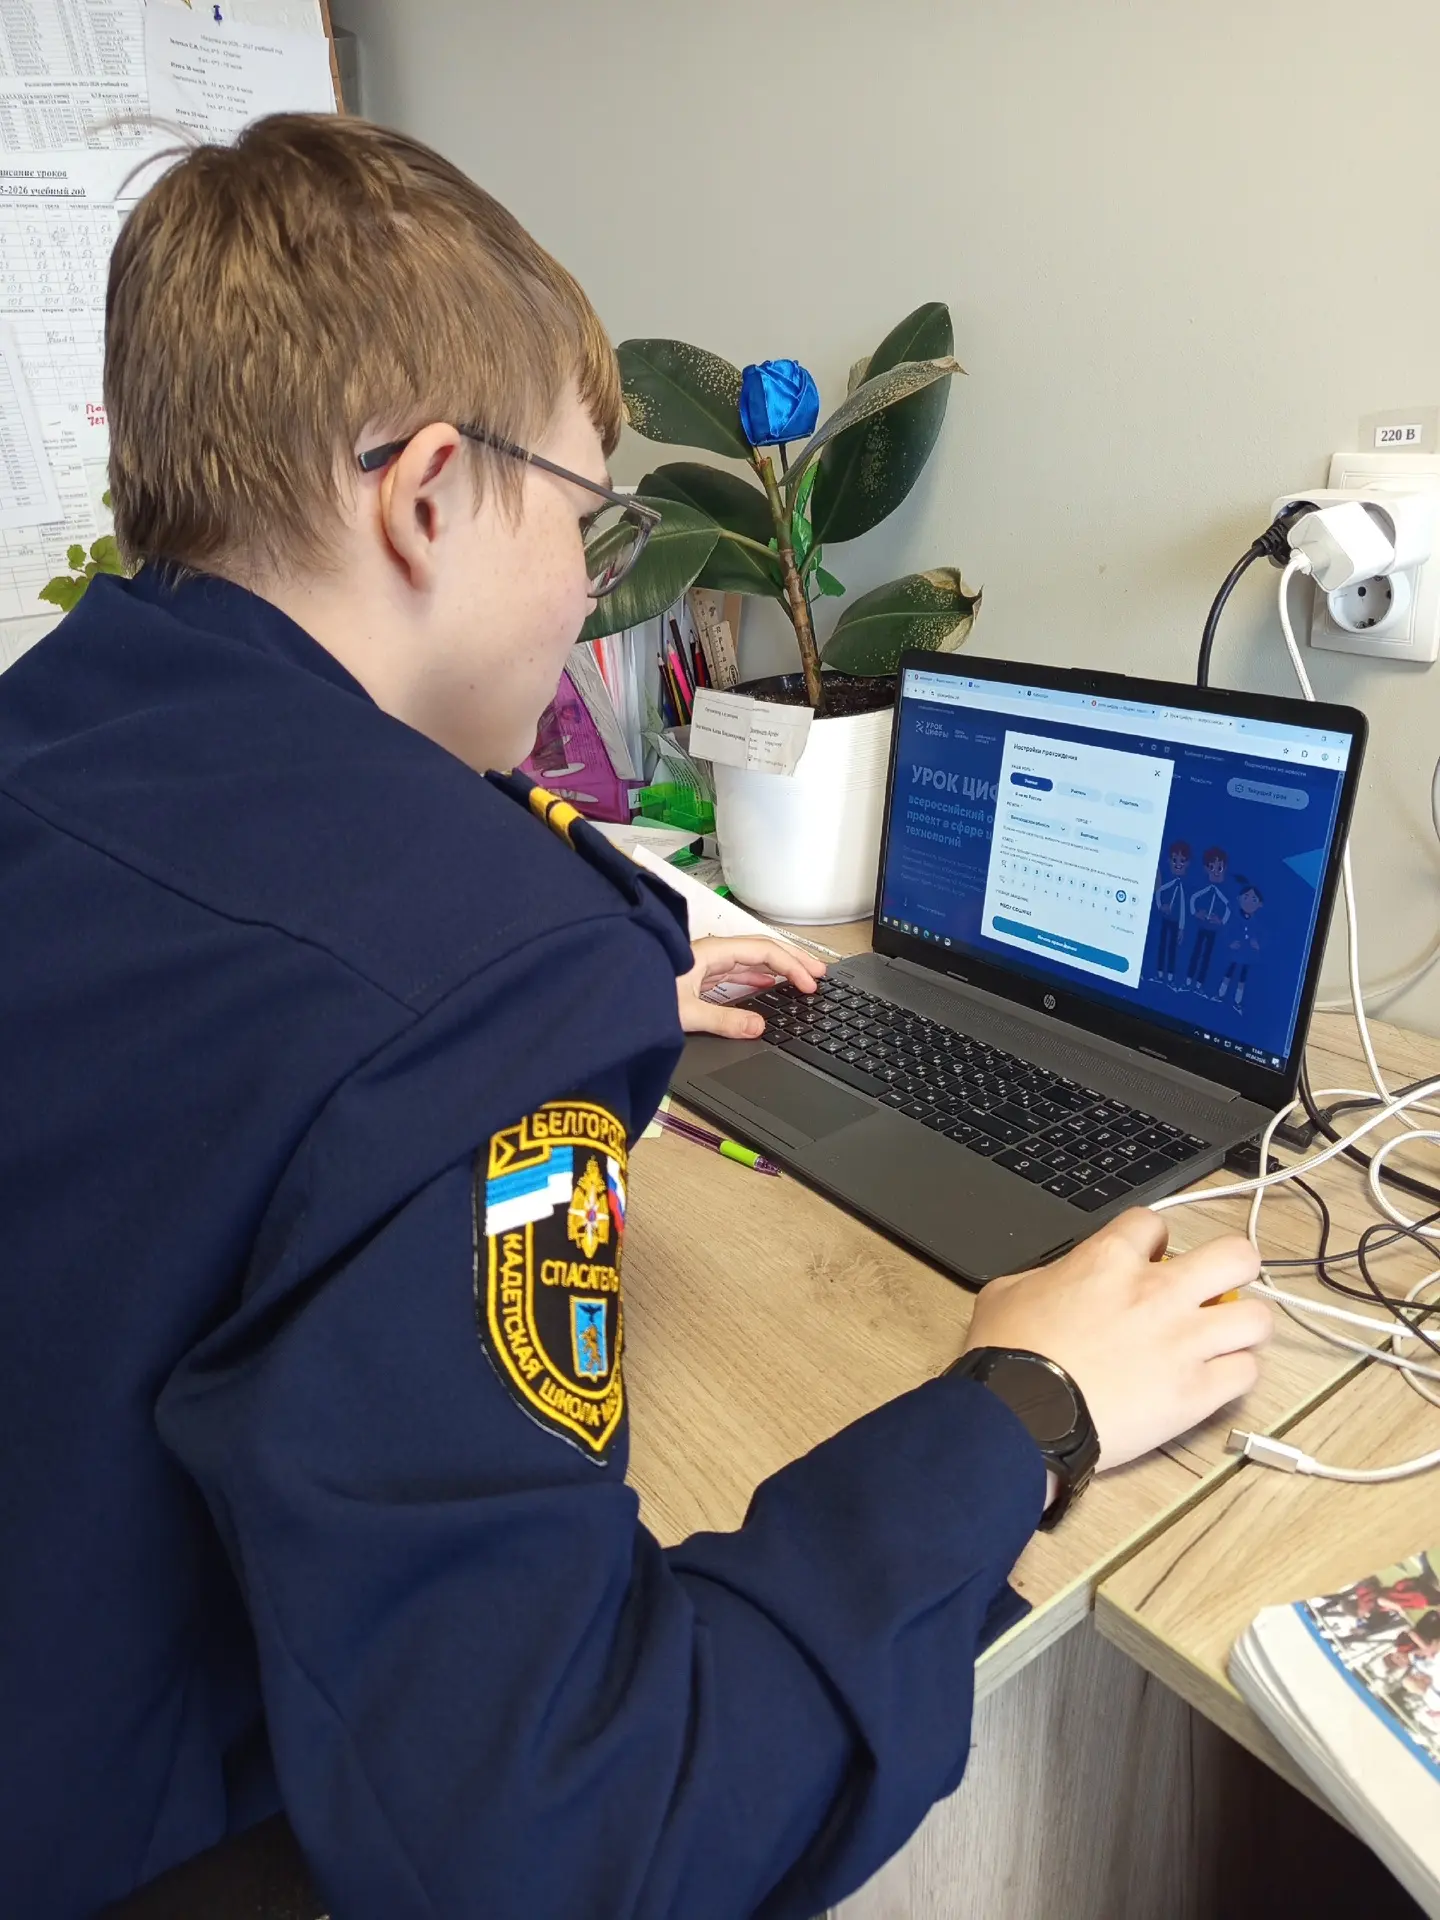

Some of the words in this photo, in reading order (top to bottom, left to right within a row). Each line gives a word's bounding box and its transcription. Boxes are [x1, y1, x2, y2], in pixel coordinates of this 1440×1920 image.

[0, 169, 35, 177] исание
[36, 170, 68, 179] уроков
[30, 186, 70, 196] учебный
[1381, 429, 1403, 442] 220
[1405, 428, 1416, 440] В
[911, 764, 960, 794] УРОК
[908, 794, 984, 821] всероссийский
[906, 809, 942, 828] проект
[943, 819, 949, 828] в
[951, 821, 984, 838] сфере
[905, 825, 962, 848] технологий
[1043, 993, 1056, 1010] hp
[532, 1109, 623, 1157] БЕЛГОРО
[499, 1232, 545, 1381] КАДЕТСКАЯ
